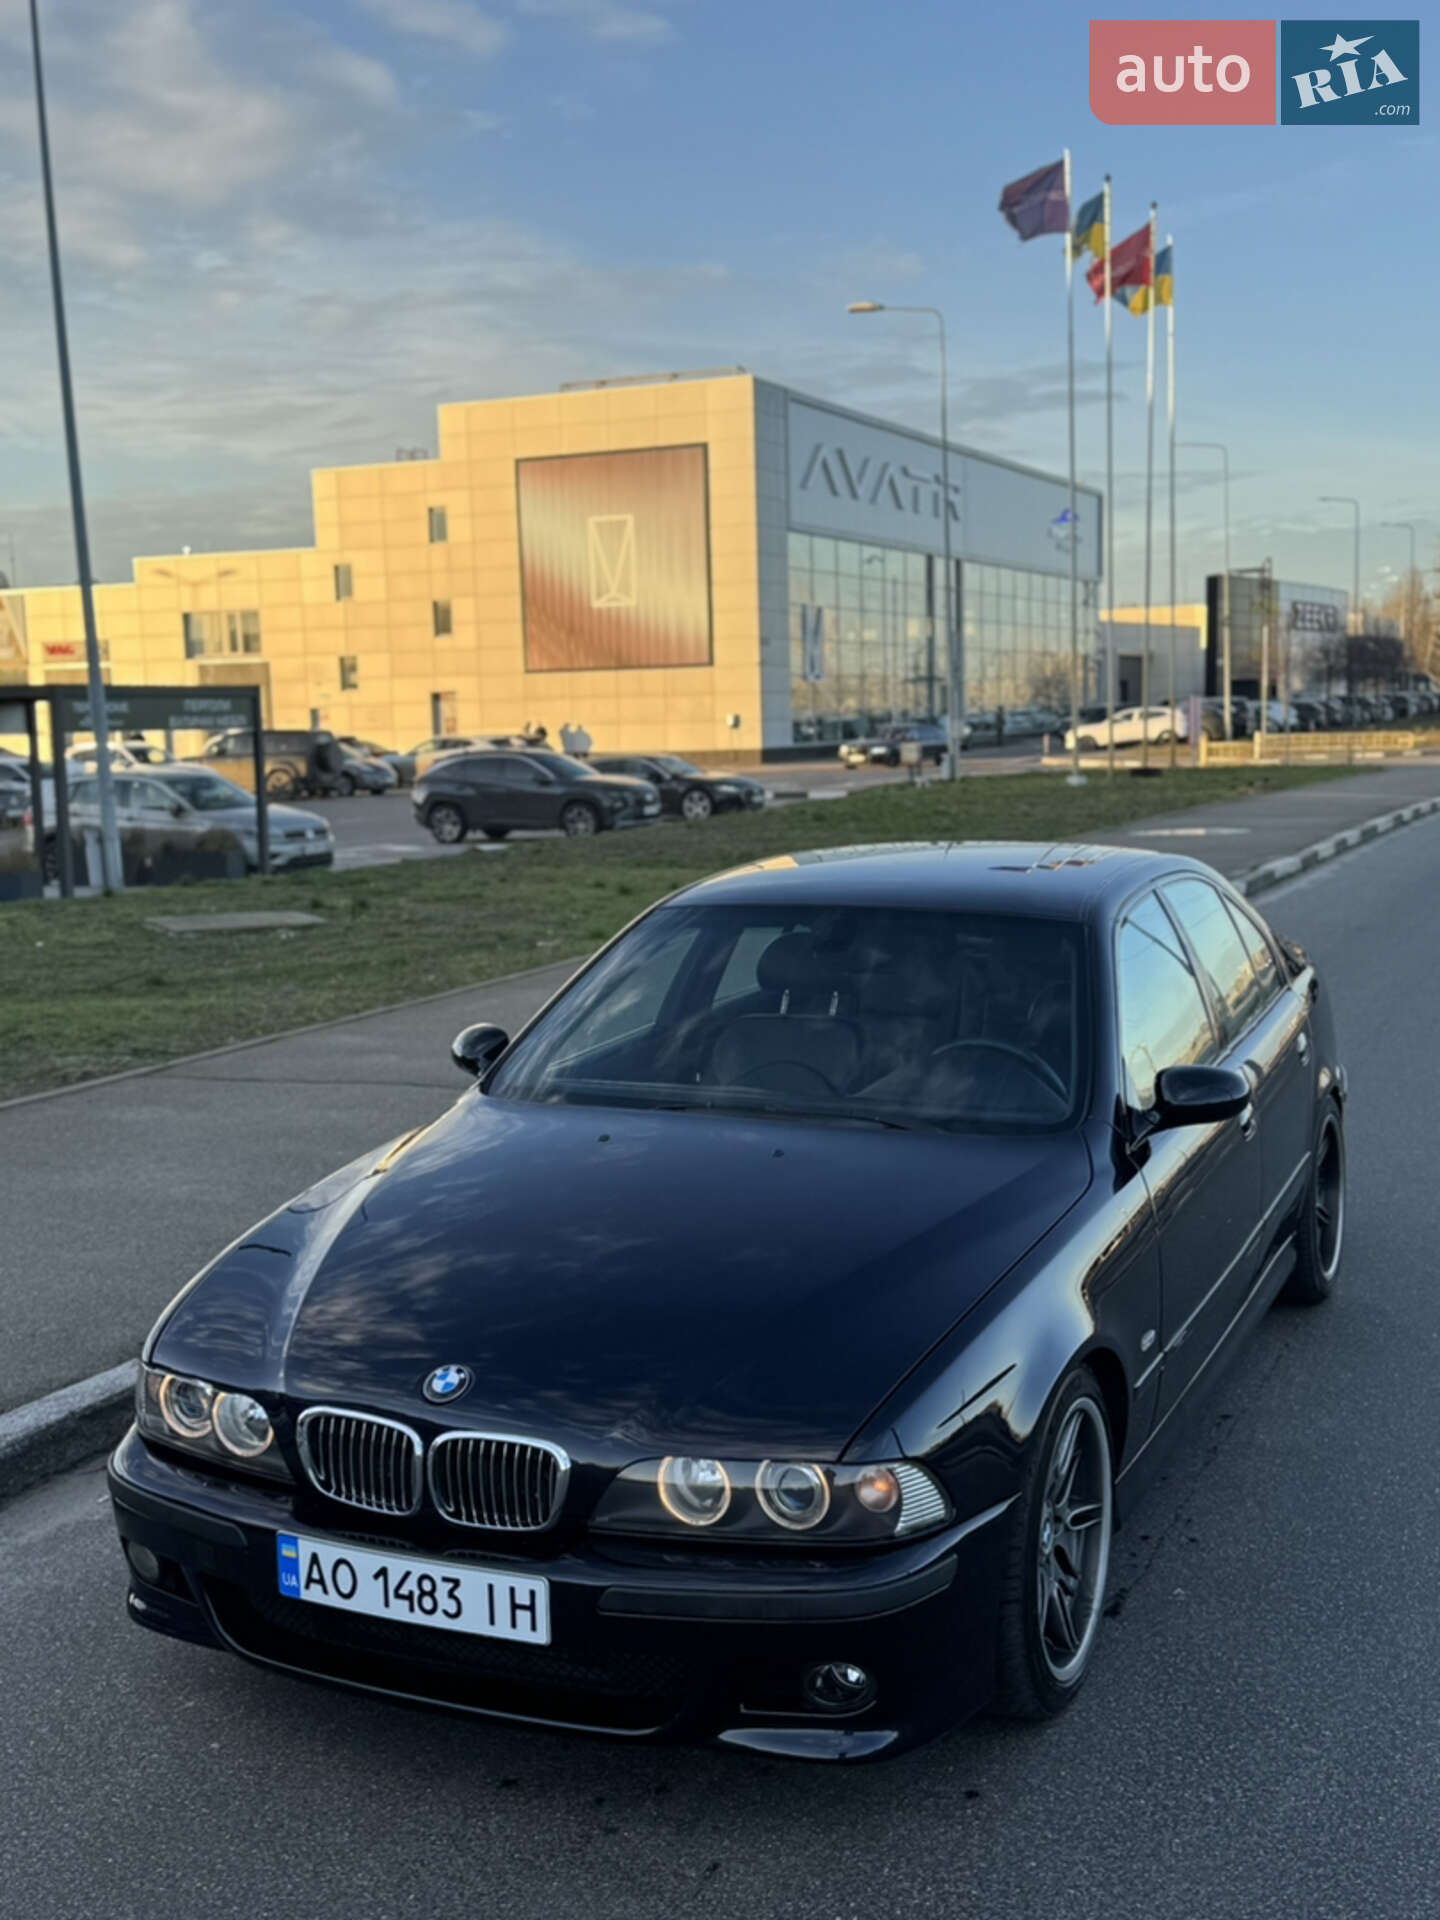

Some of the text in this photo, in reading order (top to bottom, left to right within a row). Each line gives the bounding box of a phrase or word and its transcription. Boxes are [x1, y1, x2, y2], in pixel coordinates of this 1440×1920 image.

[282, 1572, 299, 1587] UA
[304, 1552, 537, 1632] AO 1483 IH
